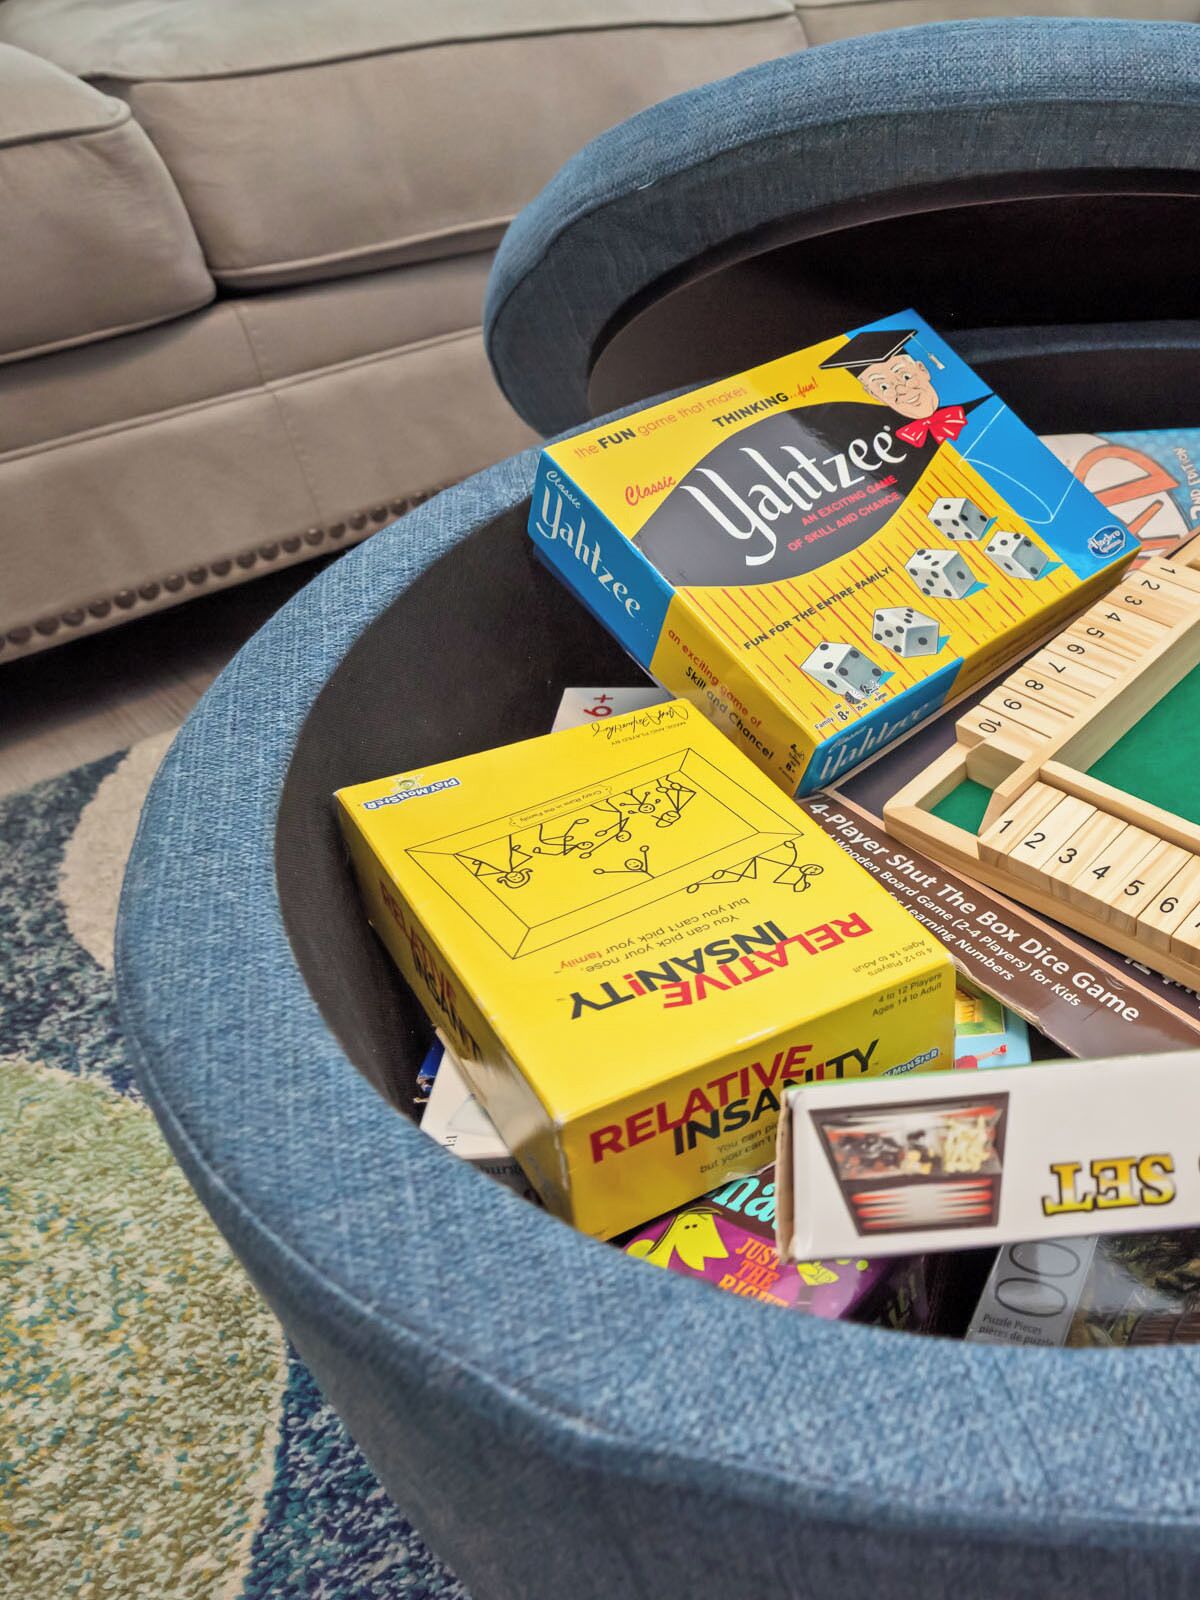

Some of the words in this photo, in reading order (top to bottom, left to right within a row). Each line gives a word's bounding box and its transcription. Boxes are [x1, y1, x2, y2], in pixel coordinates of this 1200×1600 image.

[574, 442, 600, 458] the
[597, 427, 636, 449] FUN
[638, 412, 677, 436] game
[678, 399, 705, 418] that
[706, 386, 748, 411] makes
[1173, 447, 1200, 486] EDITION
[546, 470, 581, 510] Classic
[624, 475, 677, 506] Classic
[680, 431, 907, 566] Yahtzee
[801, 513, 818, 527] AN
[818, 490, 867, 519] EXCITING
[867, 474, 898, 495] GAME
[787, 539, 804, 552] OF
[804, 522, 836, 545] SKILL
[836, 511, 859, 530] AND
[859, 491, 901, 518] CHANCE
[535, 484, 641, 618] Yahtzee
[1159, 566, 1176, 576] 1
[1141, 579, 1160, 591] 2
[743, 633, 769, 650] FUN
[768, 620, 793, 636] FOR
[792, 607, 817, 623] THE
[816, 586, 855, 610] ENTIRE
[854, 565, 894, 590] FAMILY!
[1124, 595, 1143, 606] 3
[1104, 612, 1122, 623] 4
[1086, 627, 1105, 639] 5
[1067, 644, 1085, 655] 6
[1048, 661, 1067, 674] 7
[668, 629, 681, 645] an
[682, 645, 720, 687] exciting
[720, 684, 748, 717] game
[750, 716, 763, 728] of
[1024, 679, 1044, 691] 8
[685, 666, 707, 691] Skill
[706, 689, 729, 714] and
[1003, 698, 1022, 710] 9
[978, 718, 1002, 734] 10
[999, 819, 1014, 834] 1
[1024, 832, 1046, 849] 2
[1058, 848, 1078, 864] 3
[1092, 865, 1111, 880] 4
[1124, 879, 1146, 896] 5
[1159, 896, 1179, 913] 6
[702, 904, 727, 919] you
[728, 896, 750, 911] but
[809, 803, 890, 856] 4-Player
[886, 853, 938, 889] Shut
[937, 884, 977, 914] The
[976, 911, 1021, 943] Box
[1019, 937, 1070, 976] Dice
[1071, 971, 1141, 1023] Game
[669, 916, 700, 932] can't
[687, 924, 711, 938] can
[713, 914, 740, 928] You
[834, 838, 881, 873] Wooden
[879, 871, 920, 897] Board
[917, 895, 954, 921] Game
[952, 918, 982, 938] (2-4
[979, 935, 1032, 972] Players)
[1030, 968, 1053, 985] for
[1050, 983, 1082, 1007] Kids
[639, 926, 666, 943] pick
[656, 932, 684, 948] pick
[905, 903, 956, 942] Learning
[955, 939, 1015, 981] Numbers
[605, 937, 637, 954] your
[624, 944, 655, 959] your
[903, 940, 926, 953] Ages
[559, 951, 603, 969] family
[661, 912, 873, 1009] RELATIVE
[853, 960, 877, 973] Adult
[867, 960, 903, 977] Players
[878, 995, 885, 1003] 4
[886, 991, 895, 1000] to
[898, 985, 909, 995] 12
[910, 972, 942, 991] Players
[872, 1003, 895, 1016] Ages
[898, 997, 908, 1007] 14
[909, 991, 920, 1000] to
[920, 982, 942, 995] Adult
[589, 1045, 813, 1164] RELATIVE
[717, 1138, 740, 1154] You
[741, 1129, 764, 1145] can
[700, 1159, 720, 1175] but
[720, 1150, 744, 1169] you
[744, 1137, 774, 1155] can't
[1042, 1153, 1176, 1216] SET
[735, 1237, 781, 1270] JUST
[734, 1259, 780, 1291] THE
[983, 1313, 1013, 1328] Puzzle
[1014, 1321, 1042, 1334] Pieces
[1010, 1331, 1021, 1341] de
